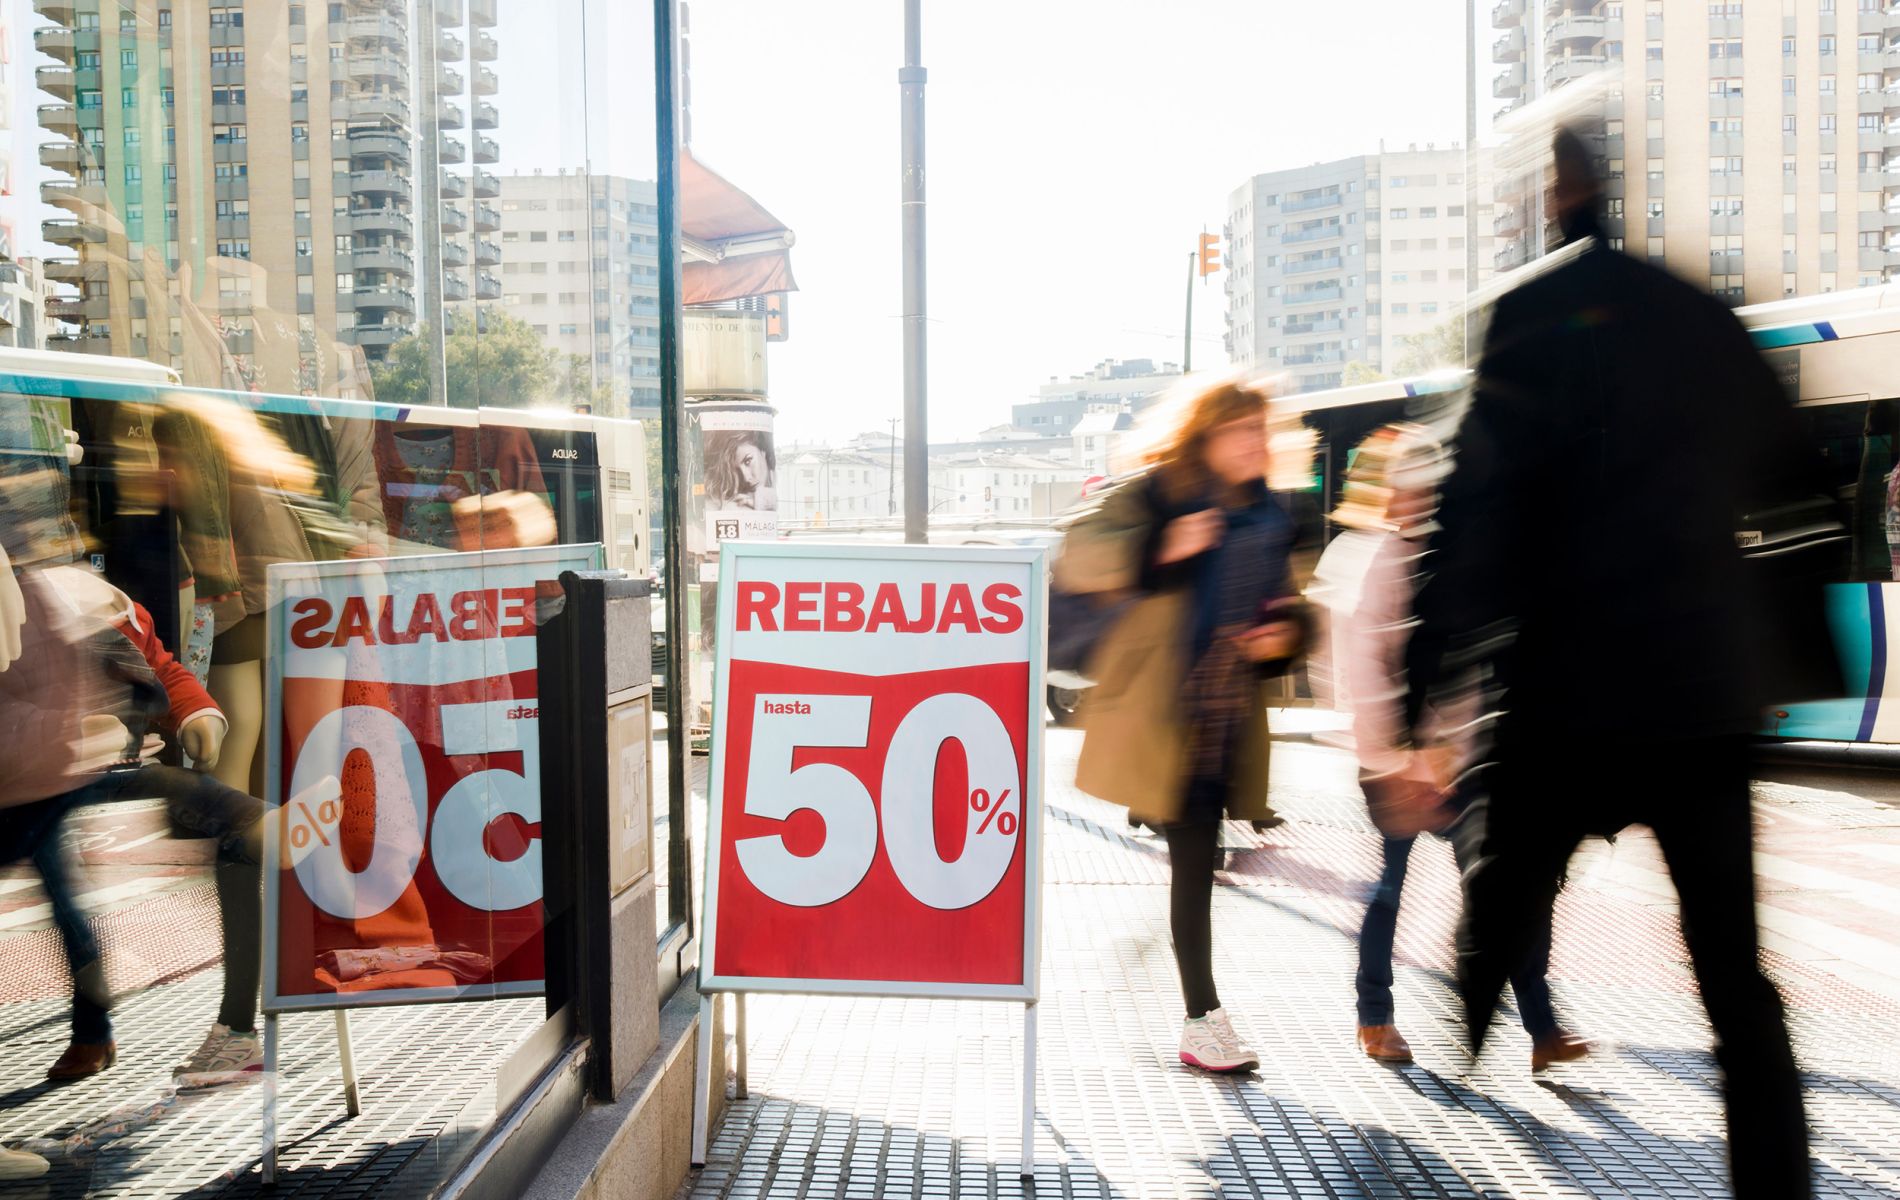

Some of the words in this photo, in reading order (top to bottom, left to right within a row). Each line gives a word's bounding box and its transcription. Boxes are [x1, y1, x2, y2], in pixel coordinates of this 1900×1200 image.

[718, 525, 737, 538] 18
[735, 580, 1024, 634] REBAJAS
[763, 700, 812, 715] hasta
